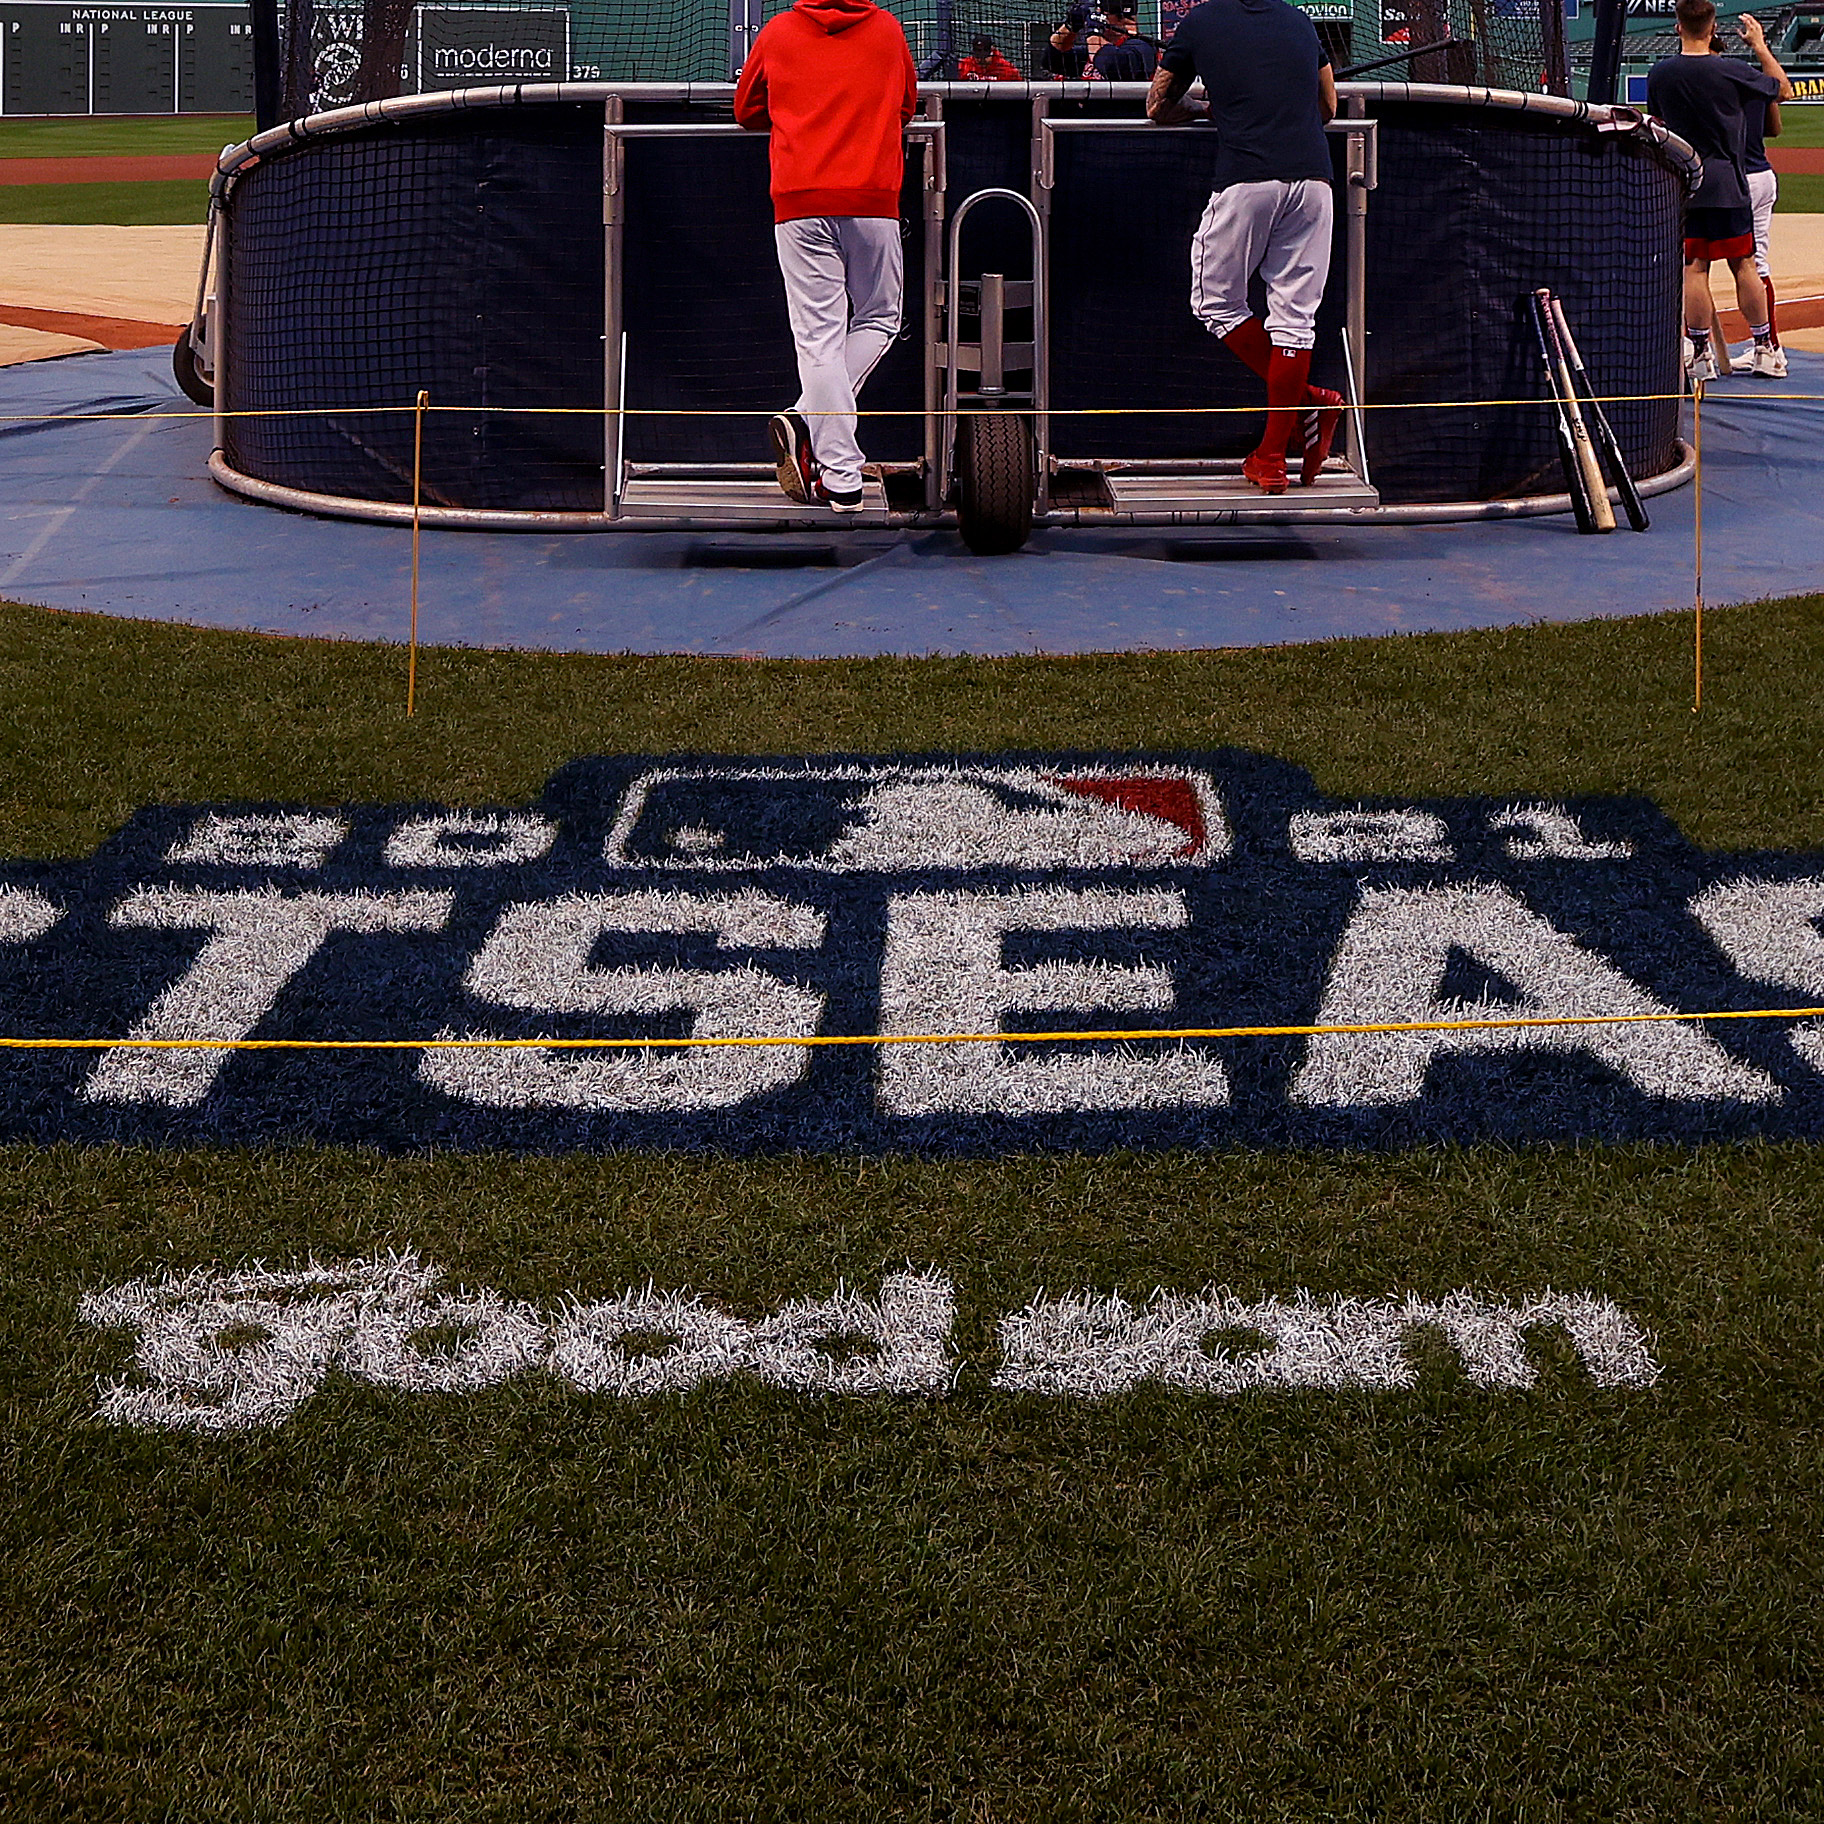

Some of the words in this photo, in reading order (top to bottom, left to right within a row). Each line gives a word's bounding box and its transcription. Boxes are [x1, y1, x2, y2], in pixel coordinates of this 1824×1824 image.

[72, 10, 137, 20] NATIONAL
[143, 10, 193, 21] LEAGUE
[435, 43, 551, 68] moderna
